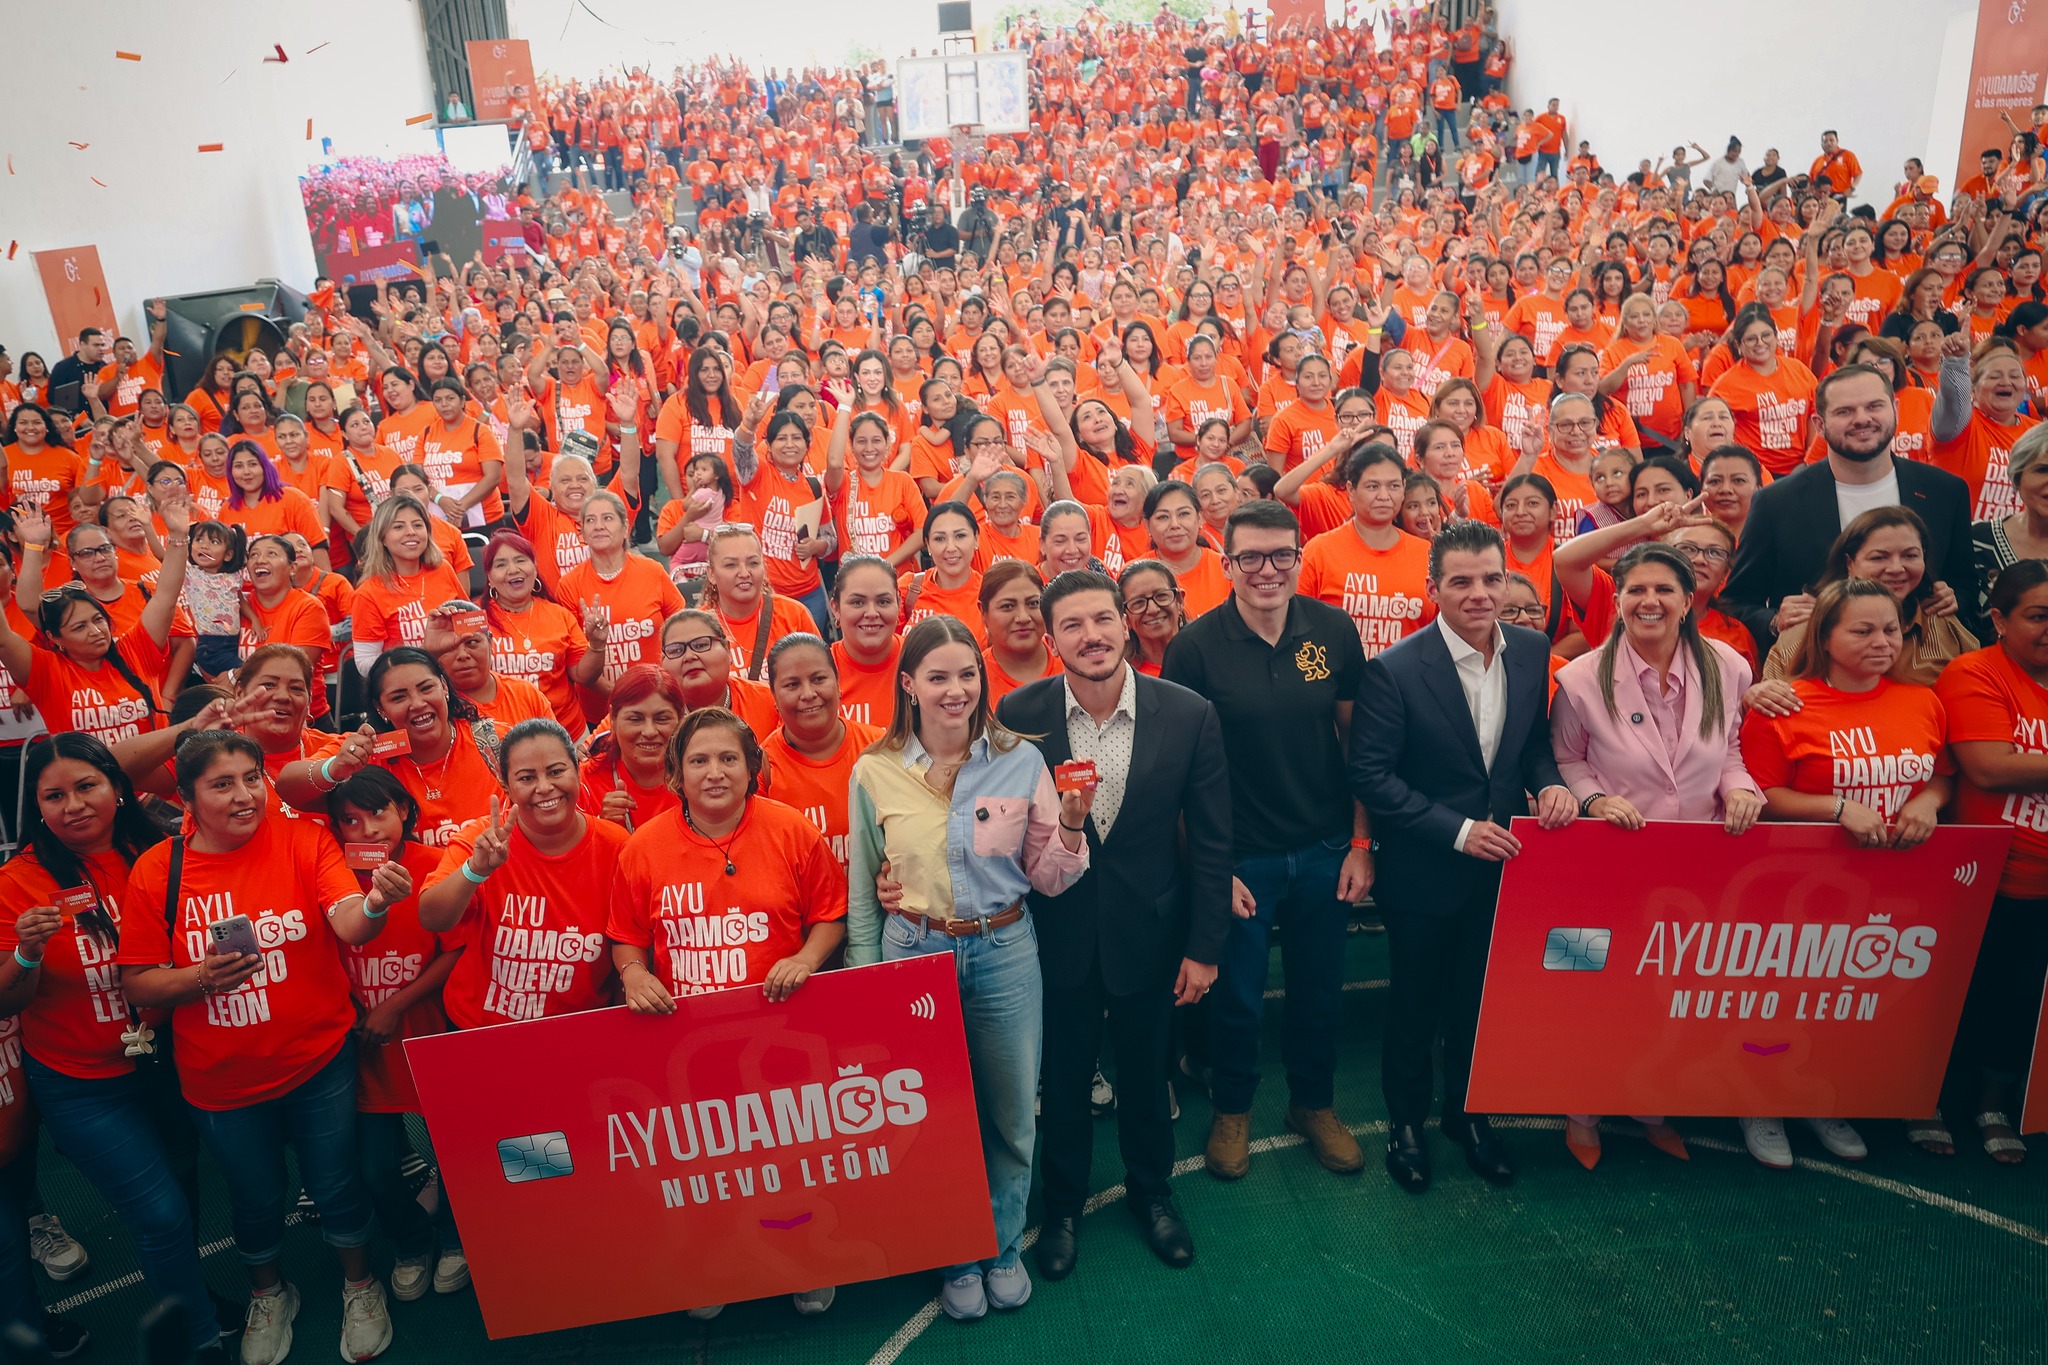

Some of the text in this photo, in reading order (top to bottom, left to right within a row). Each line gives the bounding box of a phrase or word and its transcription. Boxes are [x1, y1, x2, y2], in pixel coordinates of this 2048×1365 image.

[1976, 71, 2038, 95] AYUDAMOS
[1982, 97, 1995, 108] las
[1997, 96, 2034, 110] mujeres
[1413, 306, 1425, 315] AYU
[1537, 312, 1552, 321] AYU
[1335, 328, 1348, 339] AYU
[1412, 349, 1430, 366] AYU
[1627, 364, 1647, 377] AYU
[1628, 371, 1673, 388] DAMOS
[1507, 392, 1525, 406] AYU
[1627, 387, 1663, 401] NUEVO
[1757, 392, 1775, 407] AYU
[1009, 409, 1026, 420] AYU
[1190, 401, 1208, 412] AYU
[1389, 402, 1408, 416] AYU
[1759, 399, 1806, 422] DAMOS
[1010, 420, 1031, 433] DAM
[1502, 416, 1523, 433] NUE
[1760, 417, 1797, 434] NUEVO
[385, 431, 401, 444] AYU
[1302, 430, 1322, 444] AYU
[424, 442, 441, 452] AYU
[691, 439, 725, 453] NUEVO
[13, 469, 33, 481] AYU
[201, 486, 217, 498] AYU
[769, 496, 790, 514] AYU
[763, 512, 796, 532] DAM
[557, 533, 580, 548] AYU
[1106, 533, 1121, 549] AY
[556, 547, 592, 563] DAM
[1344, 573, 1378, 593] AYU
[398, 601, 425, 622] AYU
[1343, 592, 1423, 620] DAMOS
[606, 618, 654, 643] MOS
[72, 688, 105, 706] AYU
[72, 698, 149, 730] DAMOS
[840, 703, 870, 723] YU
[1830, 726, 1877, 757] AYU
[1833, 747, 1935, 787] DAMOS
[660, 881, 704, 917] AYU
[185, 892, 234, 927] AYU
[501, 893, 546, 927] AYU
[662, 907, 769, 948] DAMOS
[493, 926, 603, 963] DAMOS
[1636, 913, 1937, 979] AYUDAMOS
[492, 956, 574, 993] NUEVO
[669, 948, 747, 984] NUEVO
[483, 982, 547, 1021] LEÓN
[1670, 985, 1880, 1021] NUEVO LEÓN
[607, 1063, 928, 1172] AYUDAMOS
[661, 1142, 891, 1208] NUEVO LEÓN
